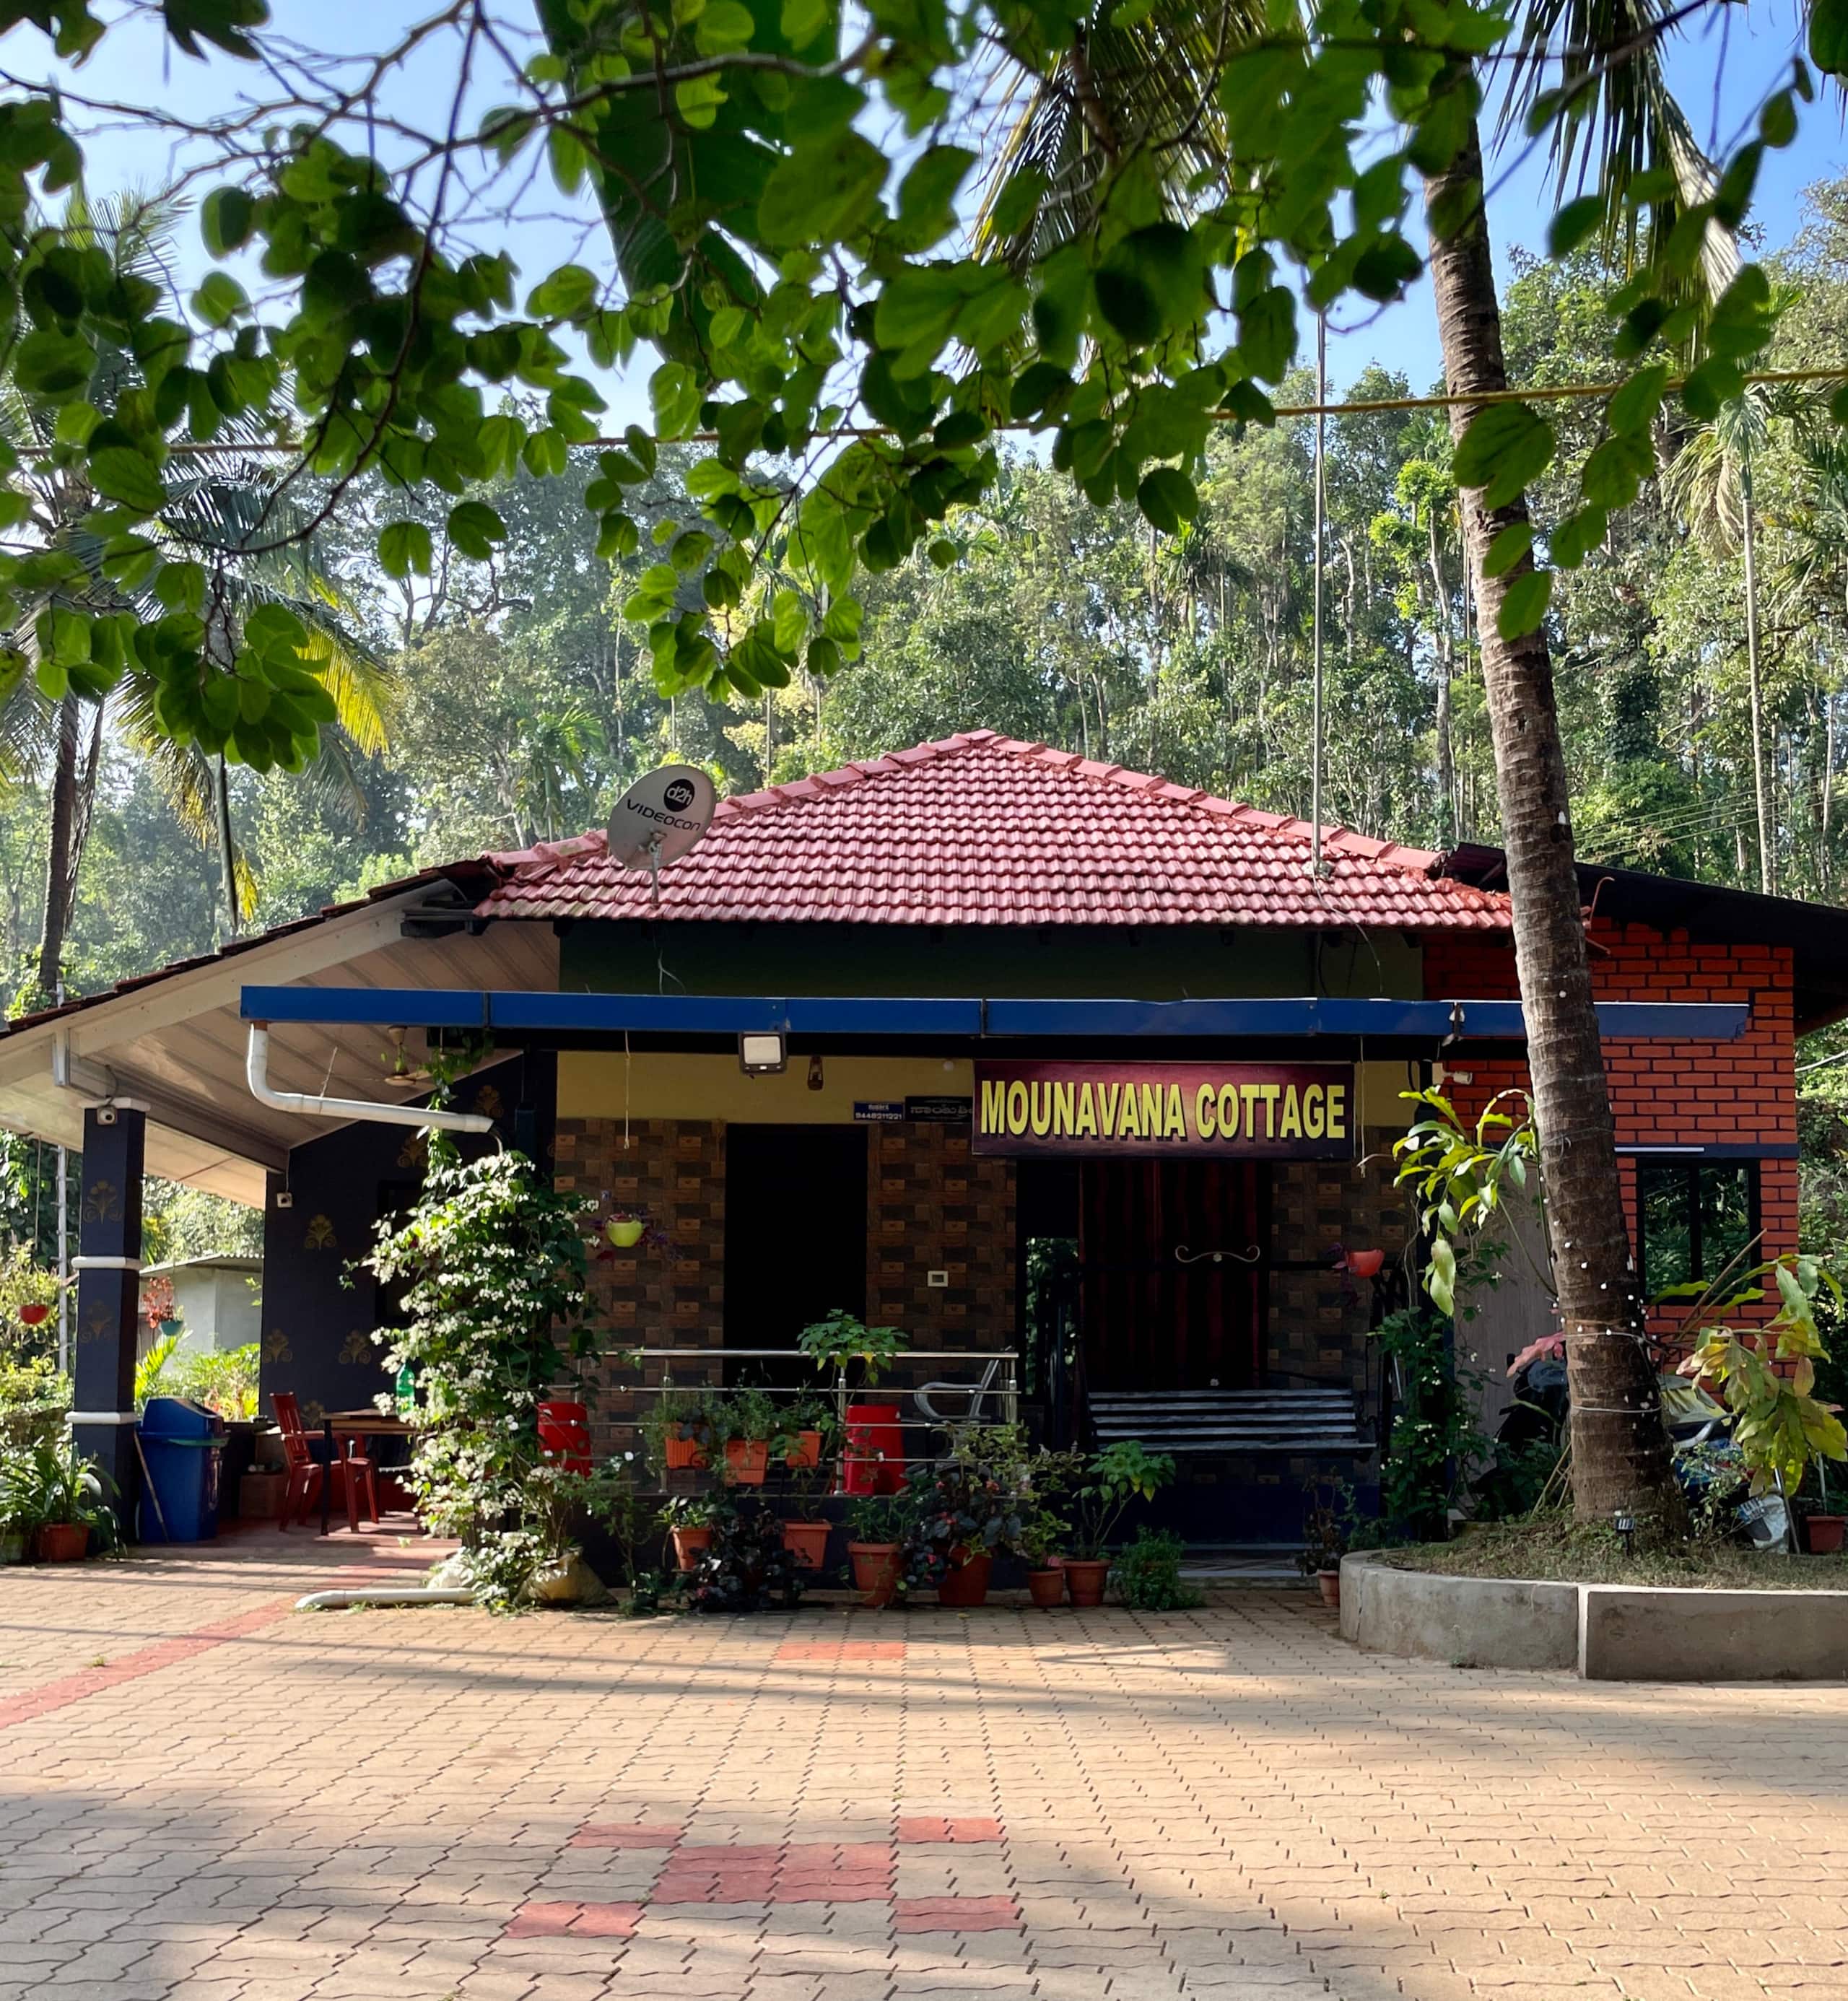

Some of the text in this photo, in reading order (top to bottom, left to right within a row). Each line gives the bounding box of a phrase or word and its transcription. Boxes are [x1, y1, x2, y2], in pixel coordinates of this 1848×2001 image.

[666, 786, 693, 805] d2h
[627, 798, 701, 831] VIDEOCON
[981, 1080, 1346, 1140] MOUNAVANA COTTAGE
